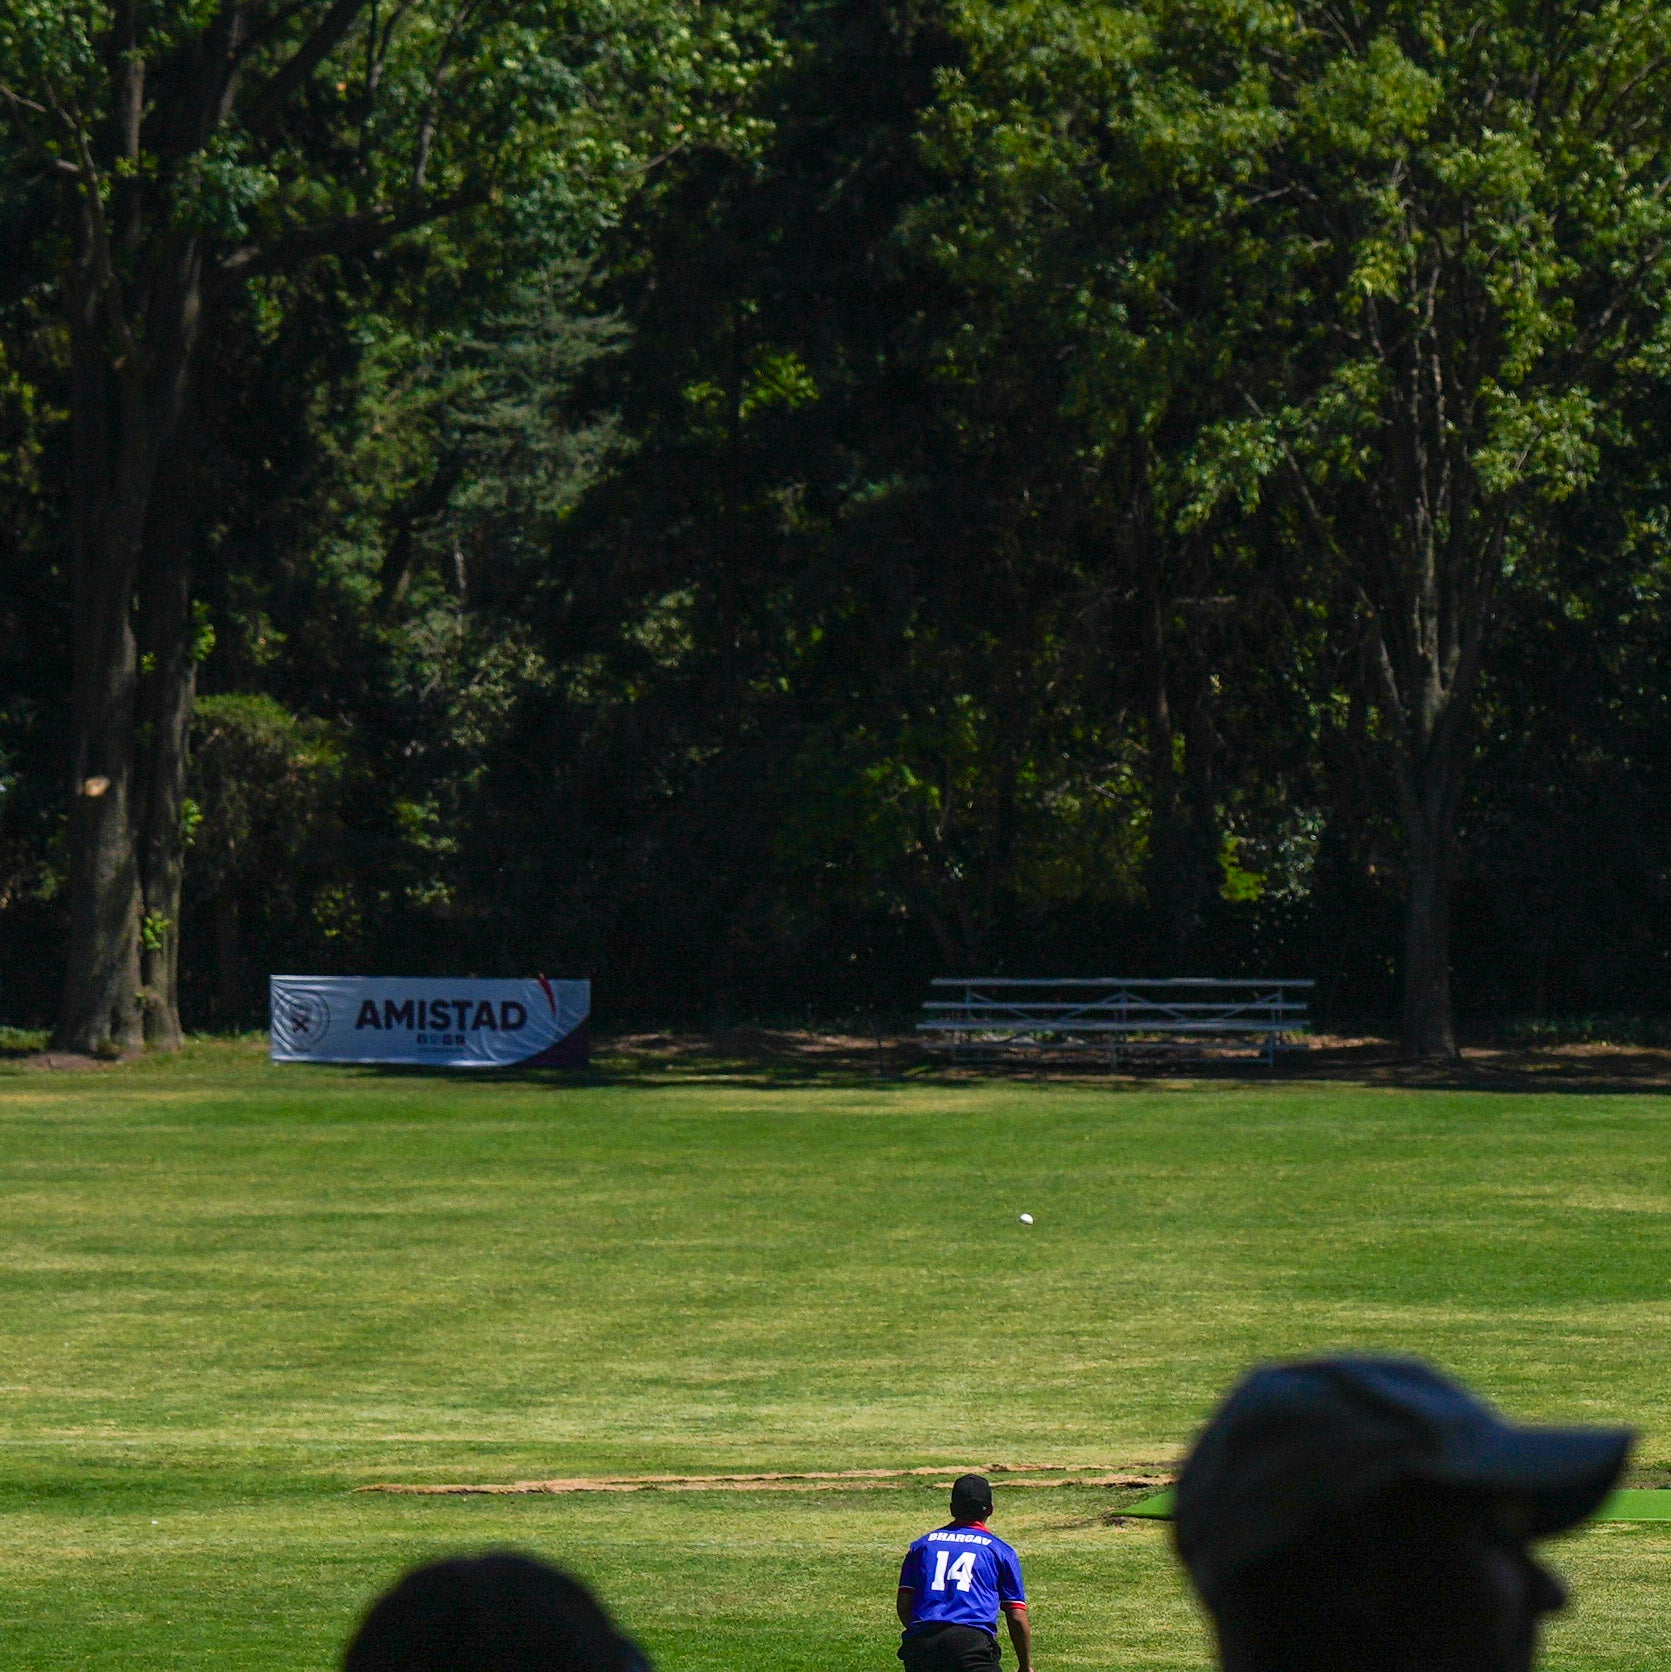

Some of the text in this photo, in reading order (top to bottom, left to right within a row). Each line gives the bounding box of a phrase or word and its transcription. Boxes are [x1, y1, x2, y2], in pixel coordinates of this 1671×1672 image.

[355, 999, 527, 1030] AMISTAD
[928, 1532, 992, 1546] BHARGAV
[931, 1551, 976, 1592] 14
